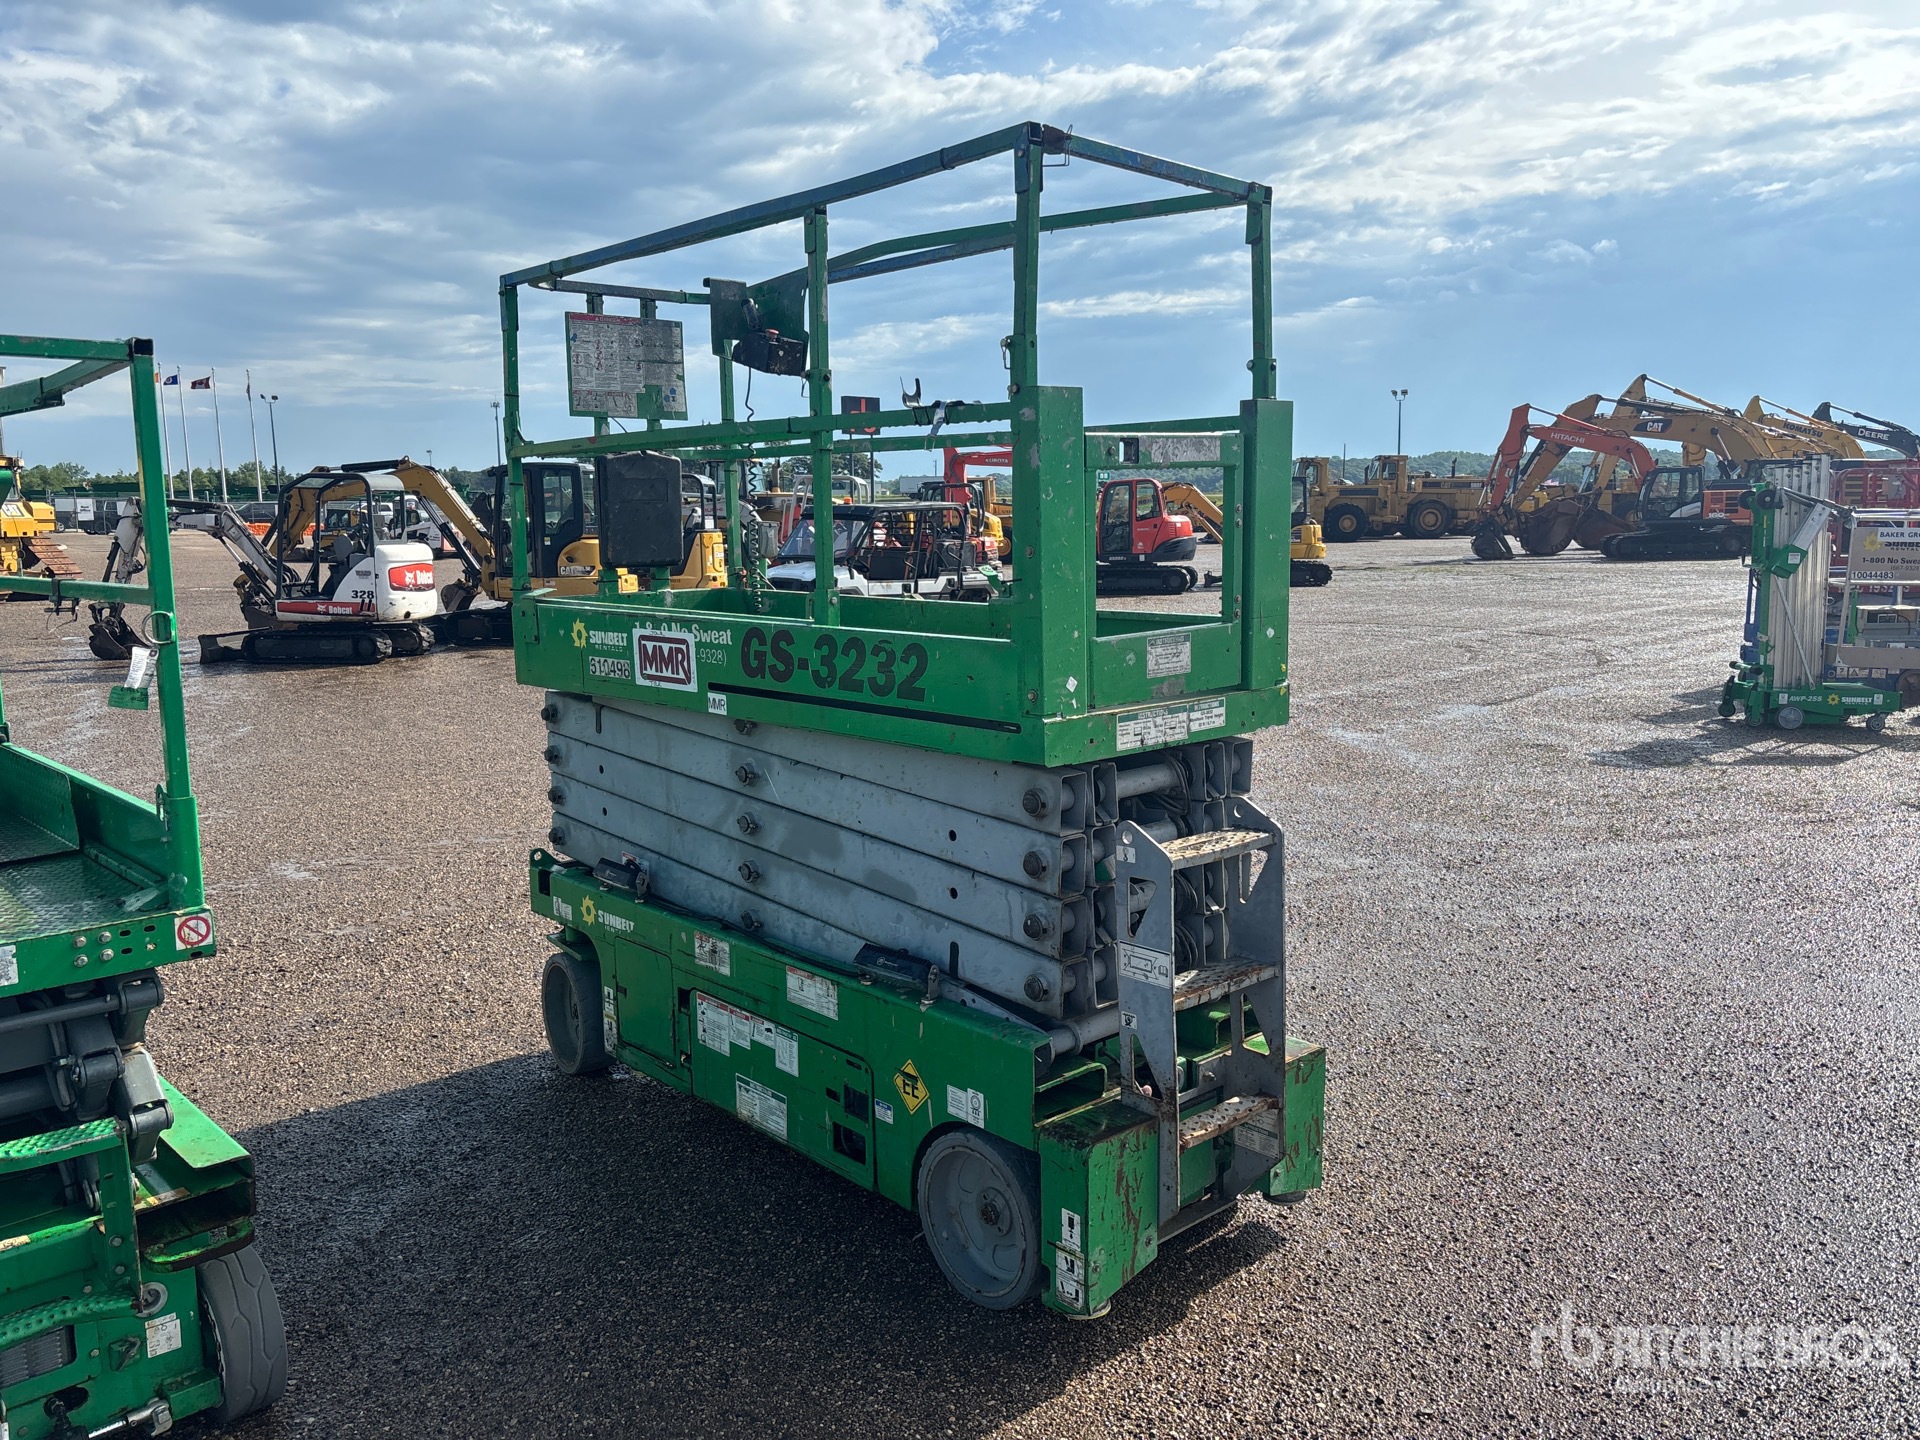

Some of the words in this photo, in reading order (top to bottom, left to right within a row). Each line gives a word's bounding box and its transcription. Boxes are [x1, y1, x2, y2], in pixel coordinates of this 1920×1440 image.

[1646, 421, 1663, 432] CAT
[1783, 422, 1824, 438] KOMATSU
[1550, 432, 1586, 444] HITACHI
[1858, 428, 1890, 441] DEERE
[1, 503, 22, 516] CAT
[560, 566, 574, 575] CAT
[1852, 571, 1894, 579] 10044483
[351, 590, 375, 599] 328
[328, 605, 353, 615] Bobcat
[589, 630, 628, 646] SUNBELT
[691, 623, 733, 645] Sweat
[642, 643, 691, 679] MMR
[741, 627, 929, 702] GS-3232
[708, 697, 727, 711] MMR
[597, 910, 635, 931] SUNBELT
